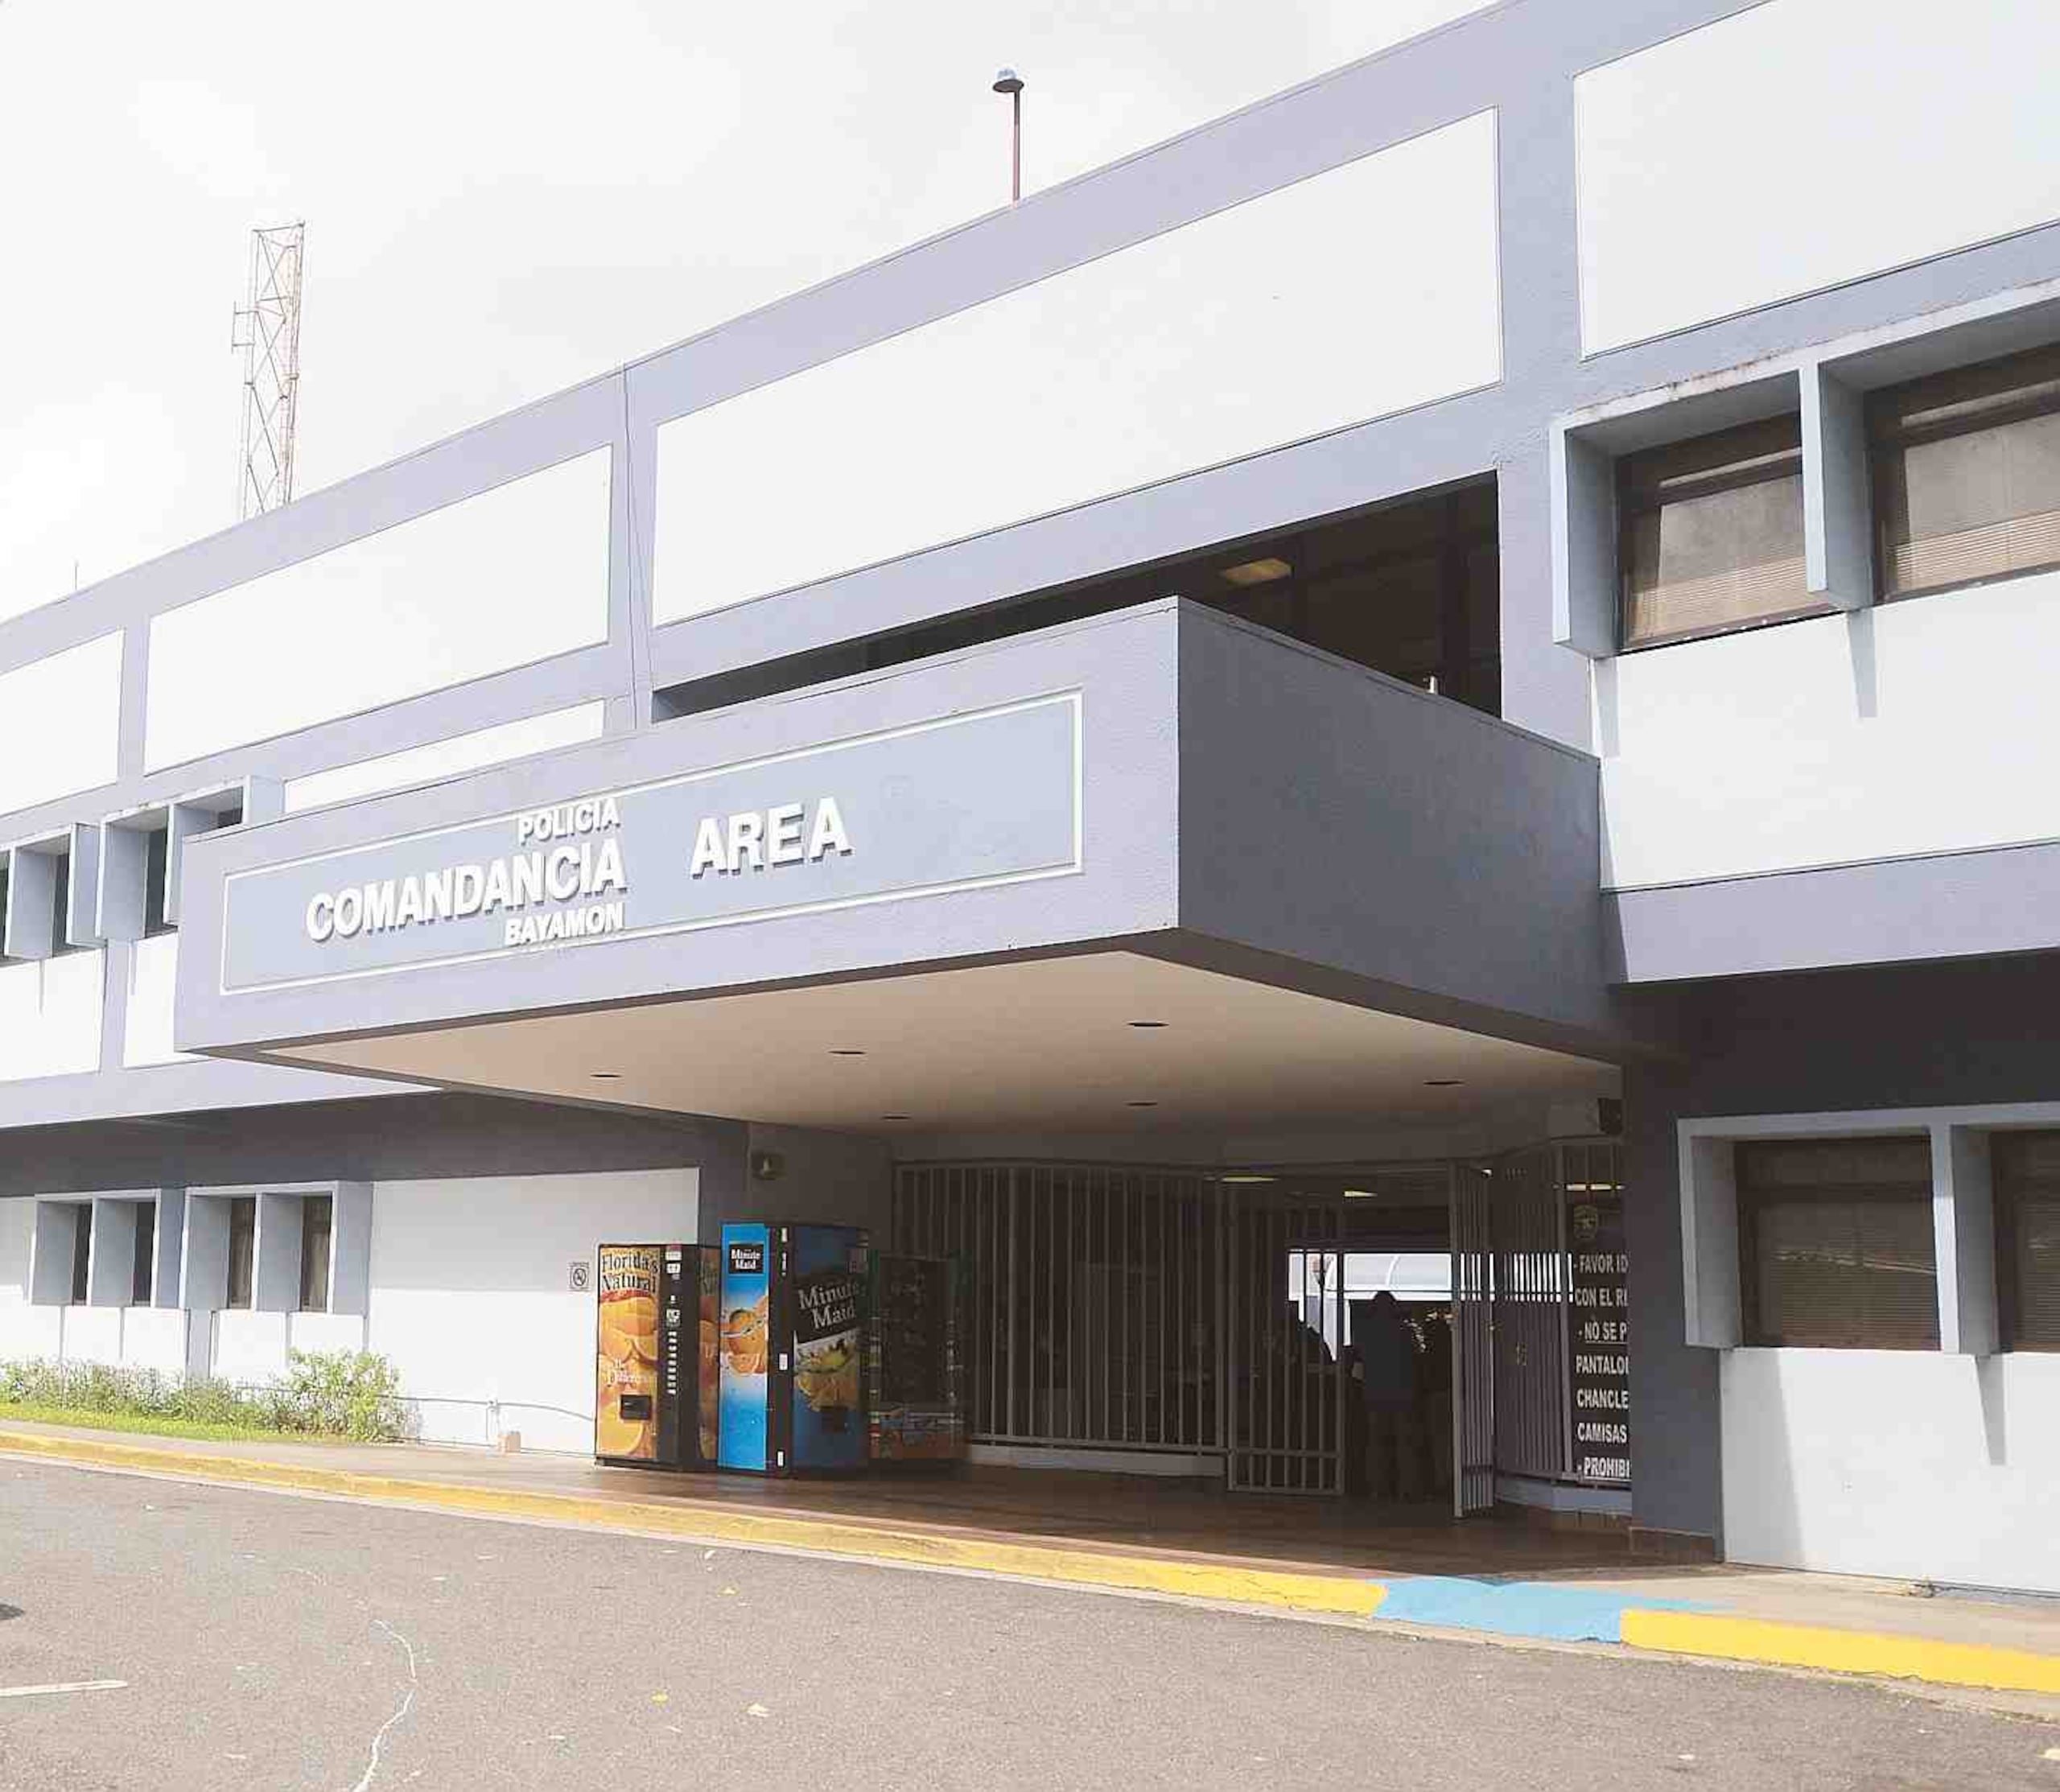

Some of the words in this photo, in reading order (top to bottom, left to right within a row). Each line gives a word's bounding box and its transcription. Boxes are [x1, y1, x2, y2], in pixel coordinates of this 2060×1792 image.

[518, 798, 620, 845] POLICIA
[307, 838, 627, 942] COMANDANCIA
[690, 797, 852, 880] AREA
[505, 902, 624, 947] BAYAMON
[1580, 1254, 1613, 1273] FAVOR
[602, 1273, 657, 1294] Natural
[797, 1282, 860, 1309] Minute
[1575, 1287, 1596, 1307] CON
[1599, 1287, 1613, 1307] EL
[812, 1297, 857, 1329] Maid
[1584, 1321, 1600, 1341] NO
[1602, 1321, 1617, 1341] SE
[1577, 1422, 1628, 1444] CAMISAS
